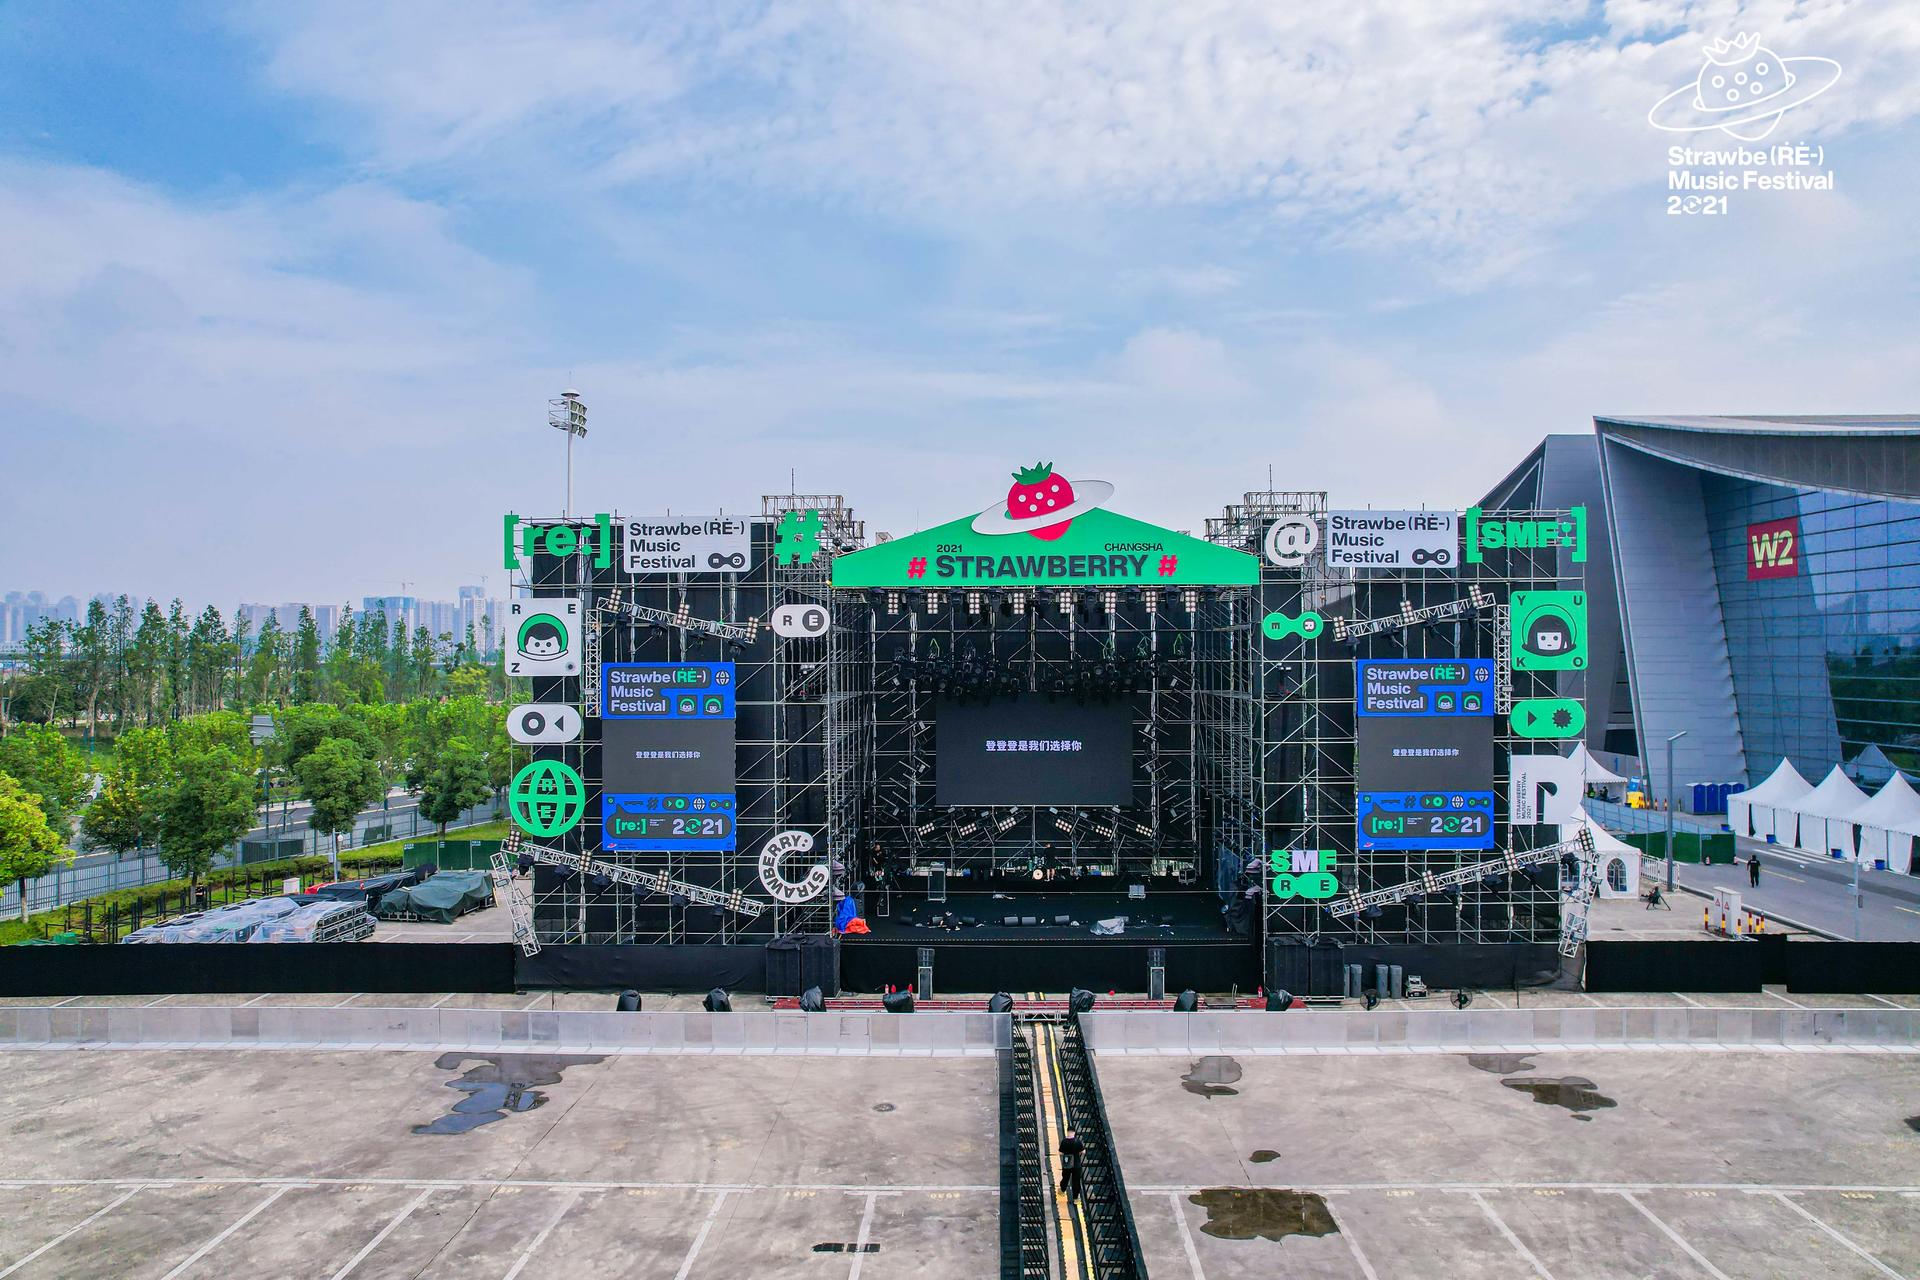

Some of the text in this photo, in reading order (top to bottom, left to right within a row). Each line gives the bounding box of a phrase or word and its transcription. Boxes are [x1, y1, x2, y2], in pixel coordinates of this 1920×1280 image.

[630, 539, 681, 553] Music
[1266, 514, 1319, 567] @
[1332, 533, 1384, 546] Music
[936, 544, 963, 553] 2021
[1104, 543, 1164, 551] CHANGSHA
[1751, 530, 1794, 568] W2
[630, 555, 695, 568] Festival
[1332, 550, 1399, 563] Festival
[936, 555, 1148, 579] STRAWBERRY
[611, 685, 654, 698] Music
[1368, 683, 1411, 695] Music
[611, 700, 666, 712] Festival
[1368, 697, 1424, 709] Festival
[985, 740, 1082, 752] 登登登是我们选择你
[1271, 850, 1337, 872] SMF
